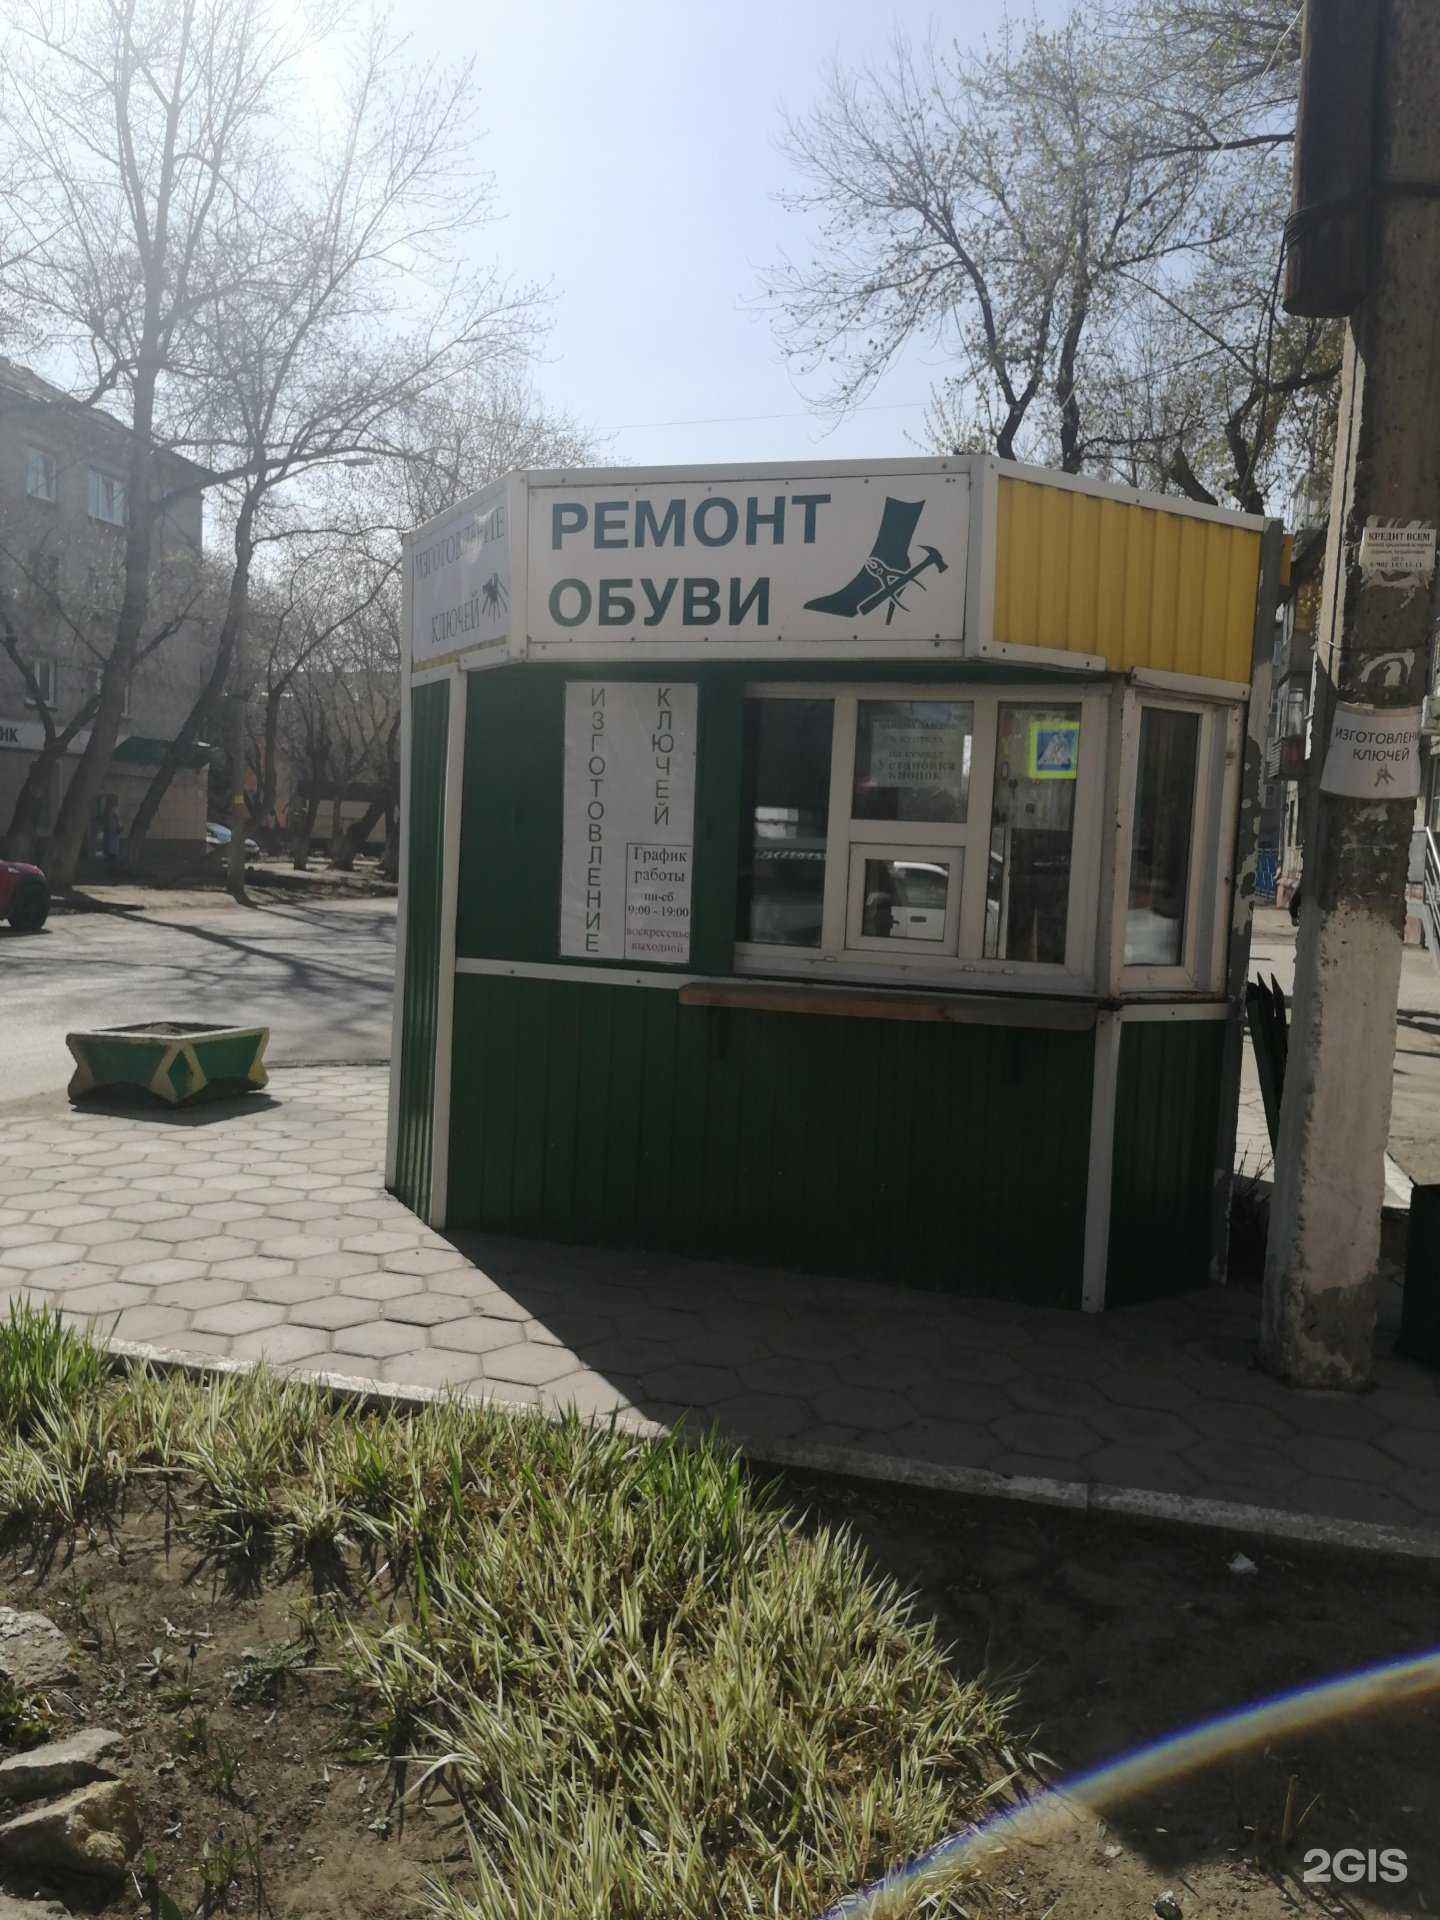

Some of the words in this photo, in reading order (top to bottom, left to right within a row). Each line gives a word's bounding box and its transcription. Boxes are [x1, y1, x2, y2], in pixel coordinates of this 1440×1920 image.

[551, 493, 832, 551] РЕМОНТ
[431, 589, 481, 644] КЛЮЧЕЙ
[548, 576, 771, 627] ОБУВИ
[651, 687, 675, 826] КЛЮЧЕЙ
[1352, 747, 1410, 761] КЛЮЧЕЙ
[585, 687, 606, 953] ИЗГОТОВЛЕНИЕ
[633, 847, 688, 864] График
[634, 867, 686, 883] работы
